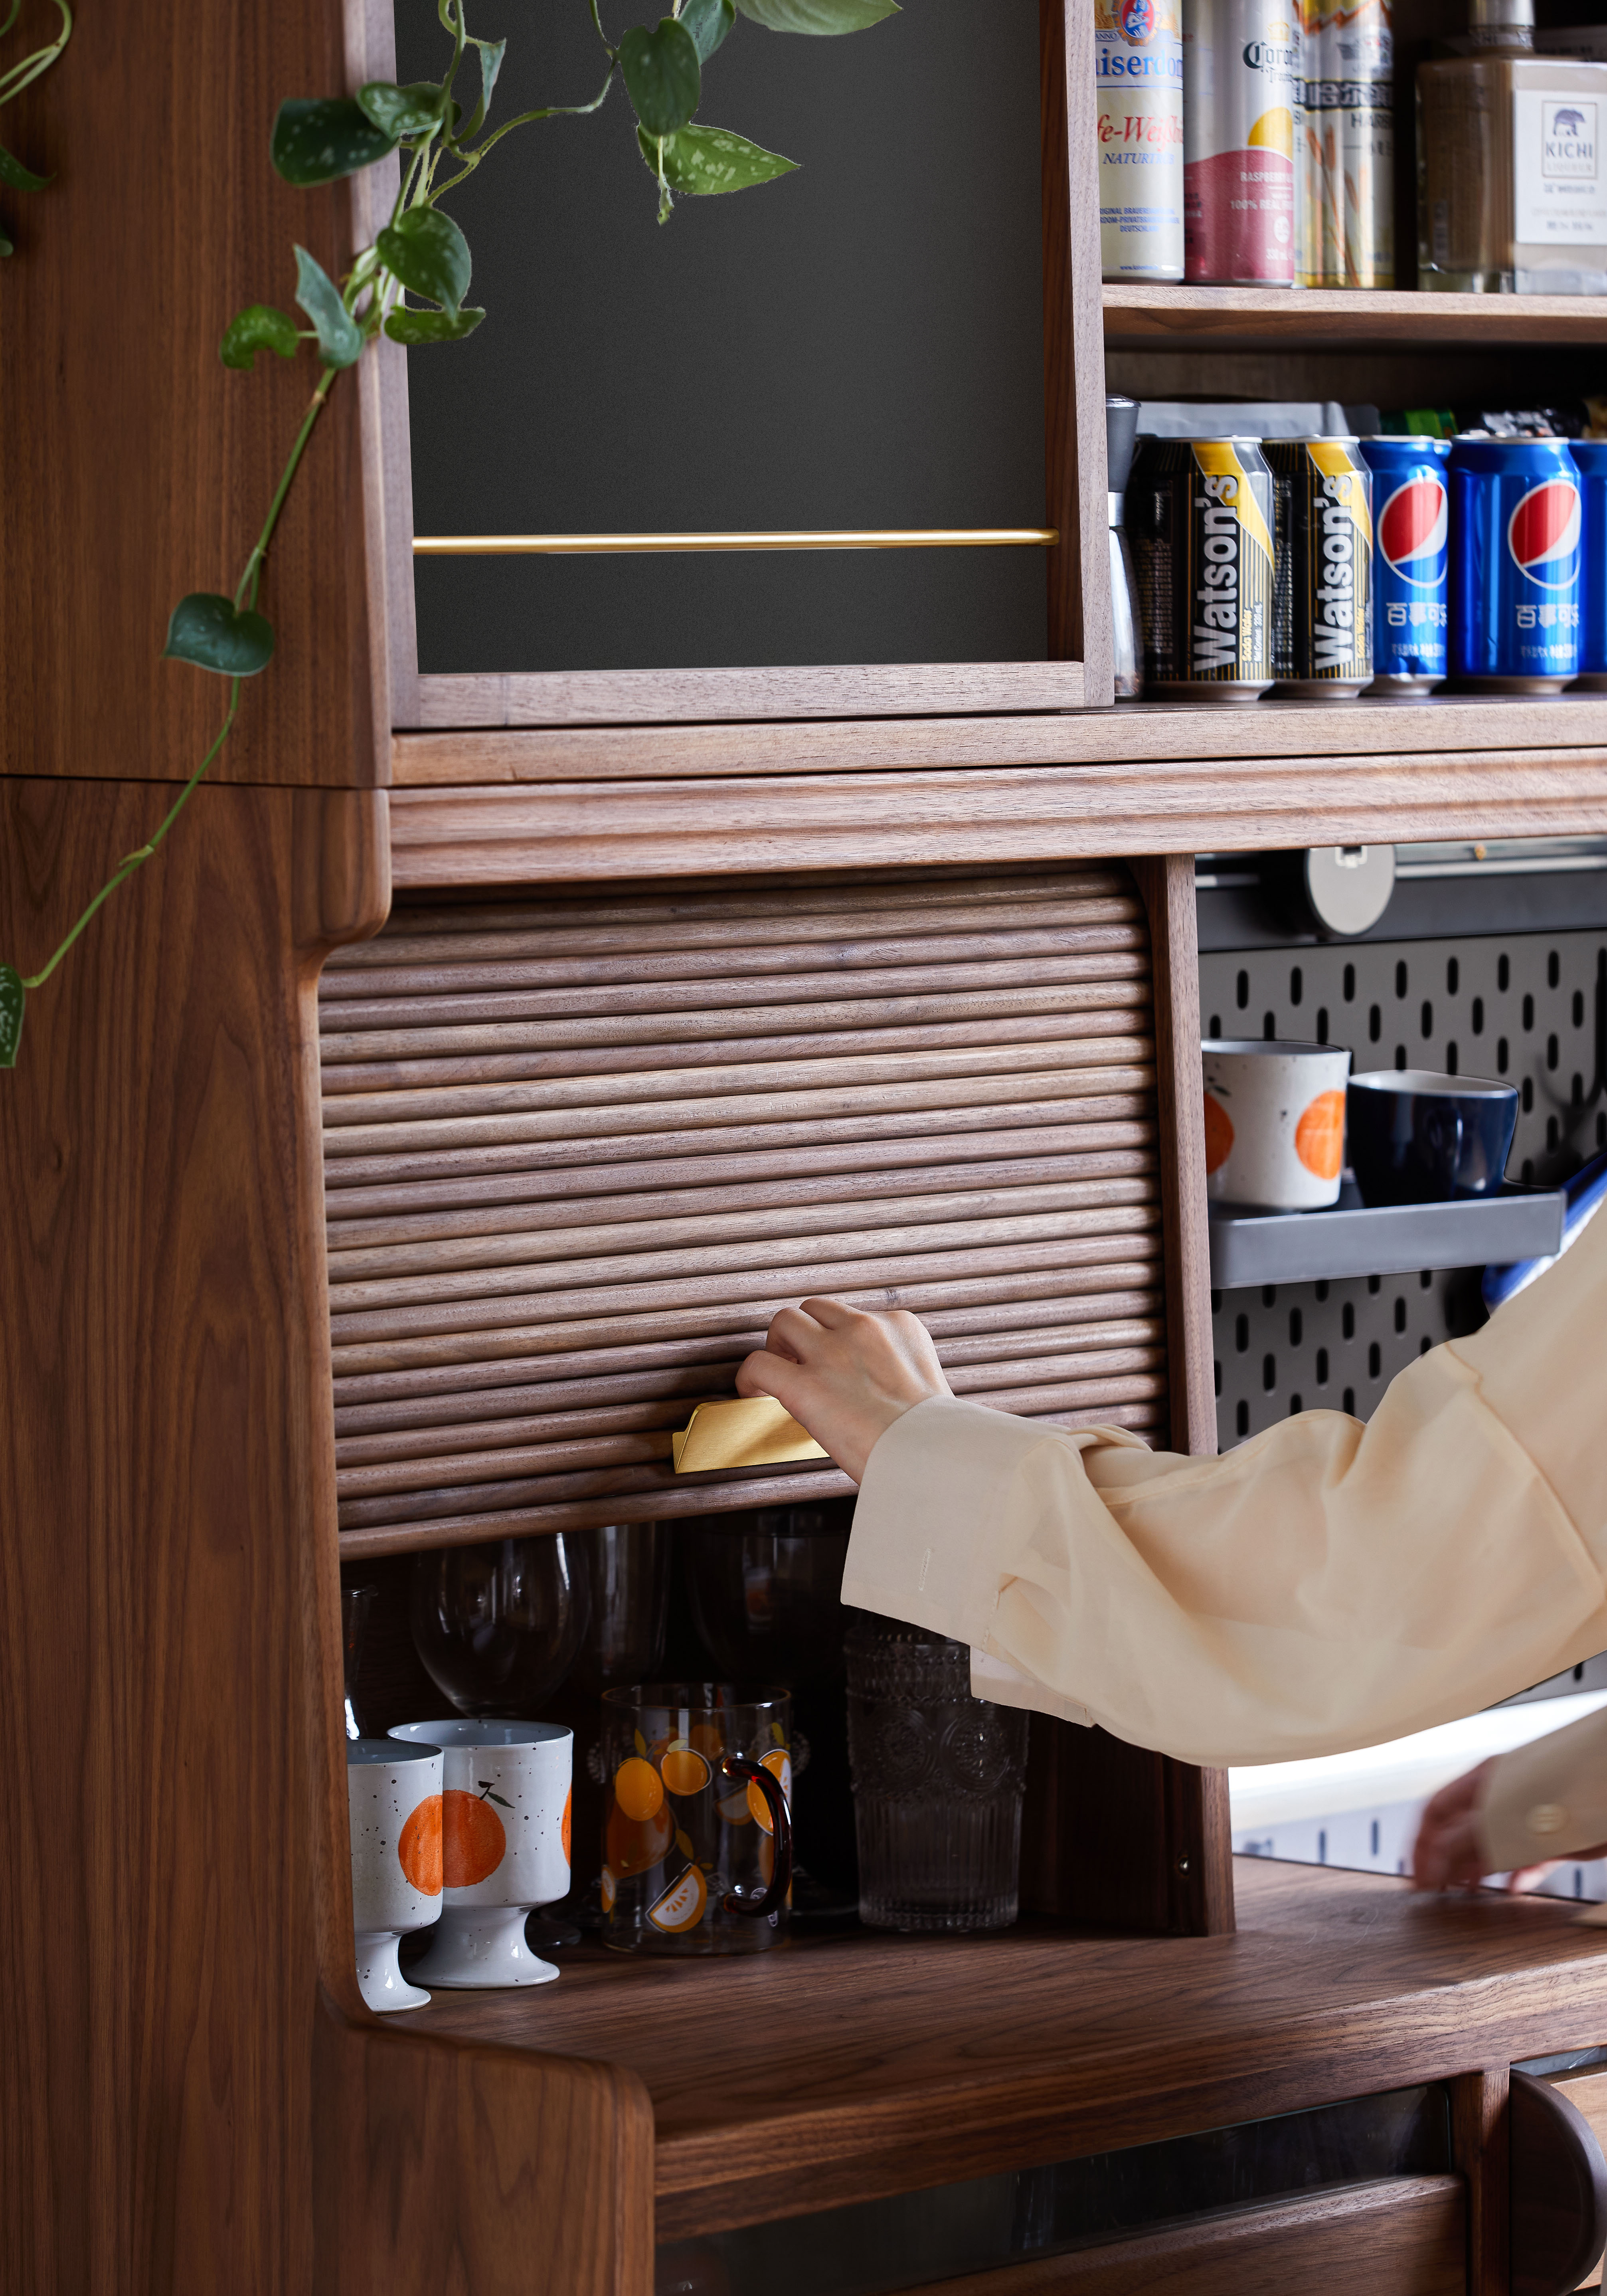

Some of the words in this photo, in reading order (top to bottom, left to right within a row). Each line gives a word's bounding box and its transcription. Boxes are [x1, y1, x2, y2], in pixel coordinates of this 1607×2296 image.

[1546, 142, 1593, 158] KICHI
[1194, 474, 1238, 672] Watson's
[1313, 475, 1353, 671] Watson's
[1242, 609, 1252, 637] Water
[1242, 637, 1252, 661] Soda
